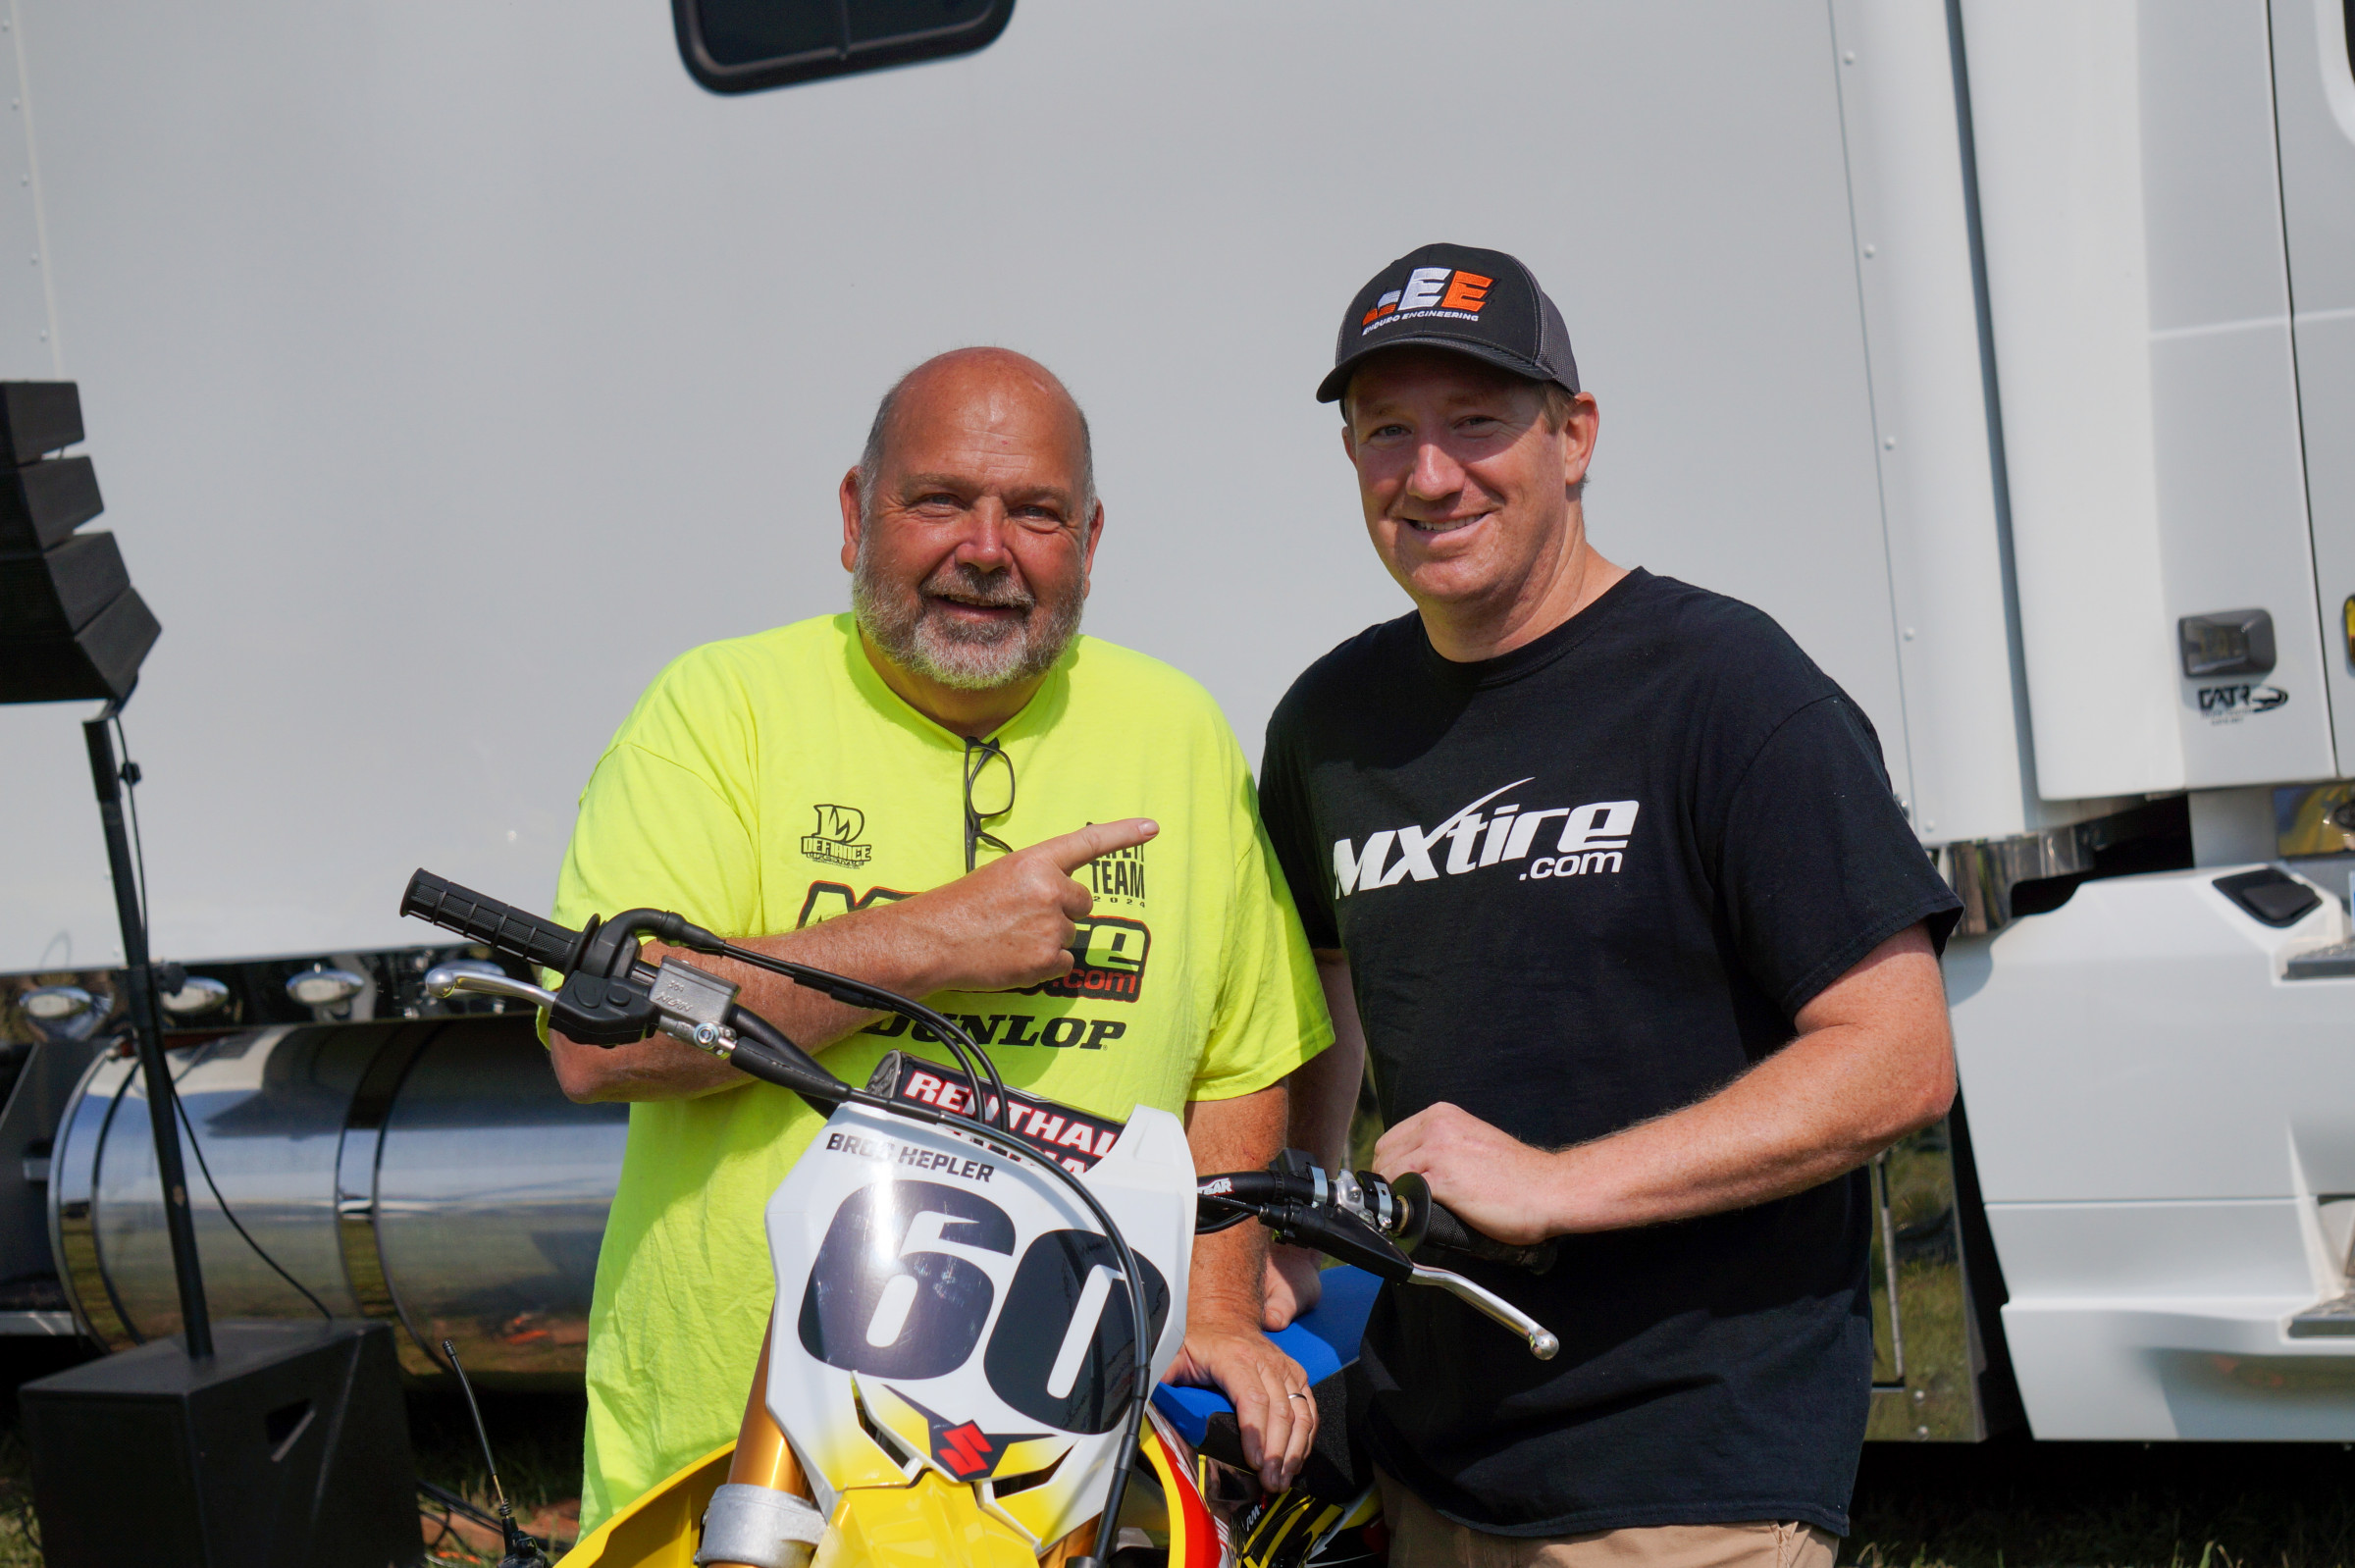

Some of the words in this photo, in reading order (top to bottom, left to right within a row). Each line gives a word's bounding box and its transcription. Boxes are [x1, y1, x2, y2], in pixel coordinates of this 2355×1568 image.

[1361, 314, 1401, 337] ENDURO
[1401, 309, 1480, 323] ENGINEERING
[800, 835, 873, 862] DEFIANCE
[1333, 776, 1641, 901] MXtire
[1088, 859, 1146, 900] TEAM
[1518, 850, 1624, 882] .com
[1092, 895, 1146, 909] 2024
[860, 1012, 1128, 1050] DUNLOP
[897, 1145, 995, 1183] HEPLER
[797, 1178, 1171, 1436] 60
